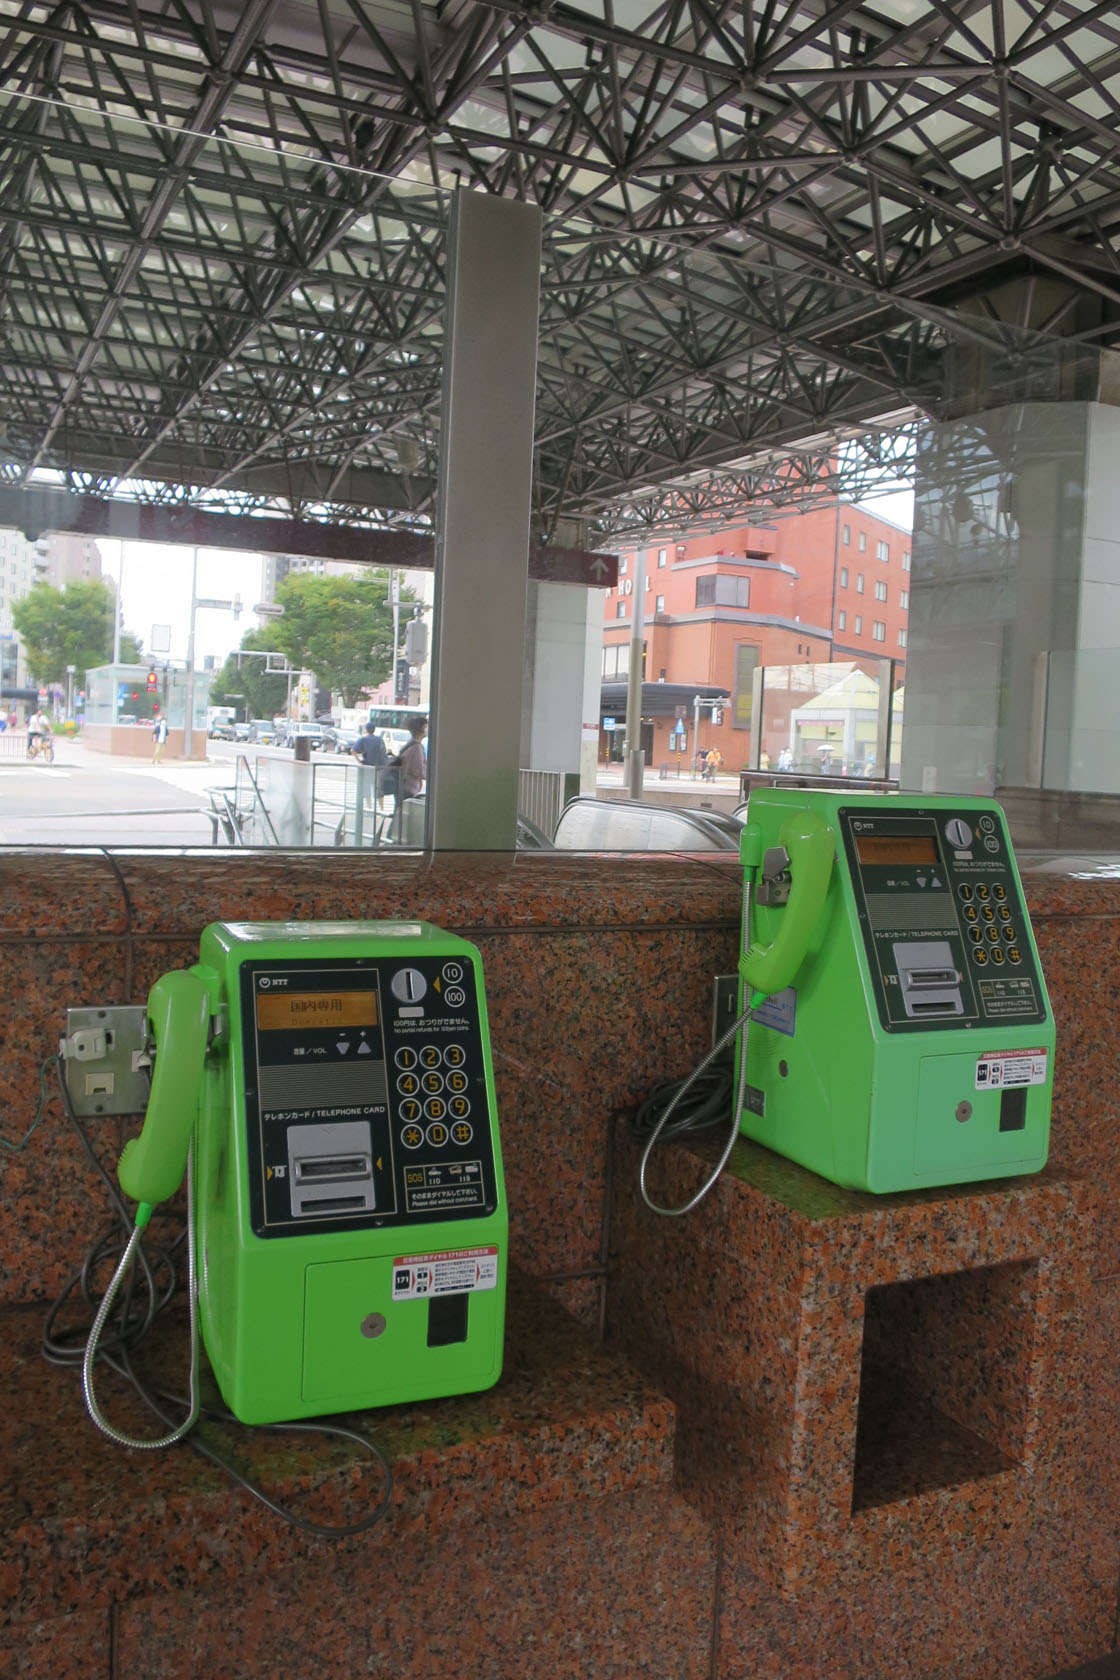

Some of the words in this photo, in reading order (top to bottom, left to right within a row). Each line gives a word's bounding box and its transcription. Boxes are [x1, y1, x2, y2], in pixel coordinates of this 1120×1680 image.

[618, 576, 651, 596] HOL
[982, 820, 992, 829] 10
[987, 840, 999, 848] 100
[980, 886, 988, 898] 2
[996, 886, 1005, 898] 3
[968, 907, 976, 919] 4
[985, 906, 993, 919] 5
[1001, 906, 1010, 918] 6
[973, 927, 980, 940] 7
[990, 927, 999, 940] 8
[1006, 927, 1014, 940] 9
[993, 949, 1003, 961] 0
[447, 968, 458, 978] 10
[272, 978, 289, 986] NTT
[448, 992, 462, 1002] 100
[290, 998, 343, 1013] 国内専用
[426, 1050, 436, 1065] 2
[451, 1049, 460, 1063] 3
[403, 1076, 413, 1092] 4
[429, 1075, 438, 1090] 5
[452, 1074, 463, 1088] 6
[264, 1111, 311, 1121] テレホンカード
[316, 1107, 361, 1117] TELEPHONE
[363, 1106, 385, 1114] CARD
[407, 1103, 416, 1118] 7
[430, 1101, 441, 1116] 8
[455, 1100, 465, 1114] 9
[432, 1126, 443, 1142] 0
